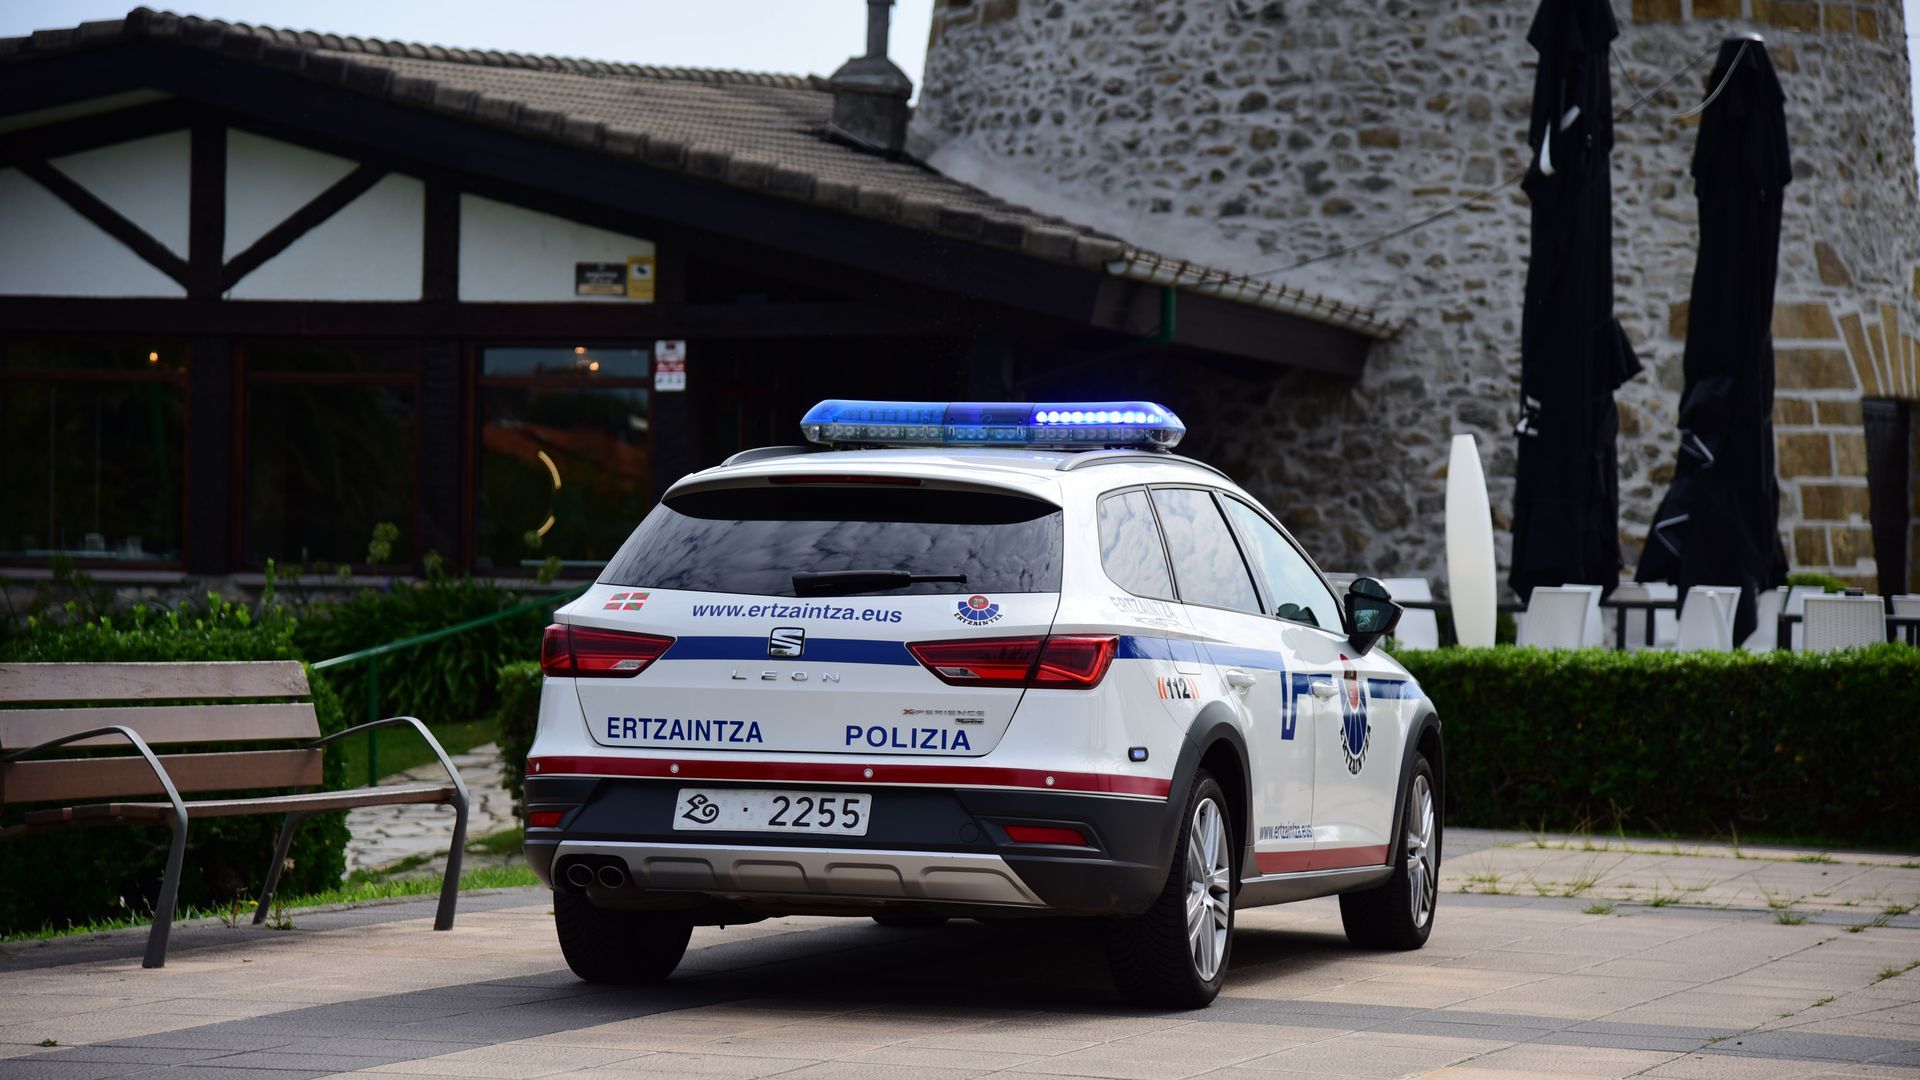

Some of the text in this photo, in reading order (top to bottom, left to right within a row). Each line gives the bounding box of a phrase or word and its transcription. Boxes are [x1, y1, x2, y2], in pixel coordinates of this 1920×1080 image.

[692, 603, 902, 623] www.ertzaintza.eus
[954, 612, 1004, 626] ERTZAINTZA
[731, 669, 840, 683] LEON
[607, 716, 764, 743] ERTZAINTZA
[845, 725, 971, 750] POLIZIA
[768, 795, 861, 829] 2255
[1259, 820, 1313, 840] www.ertzaintza.eus
